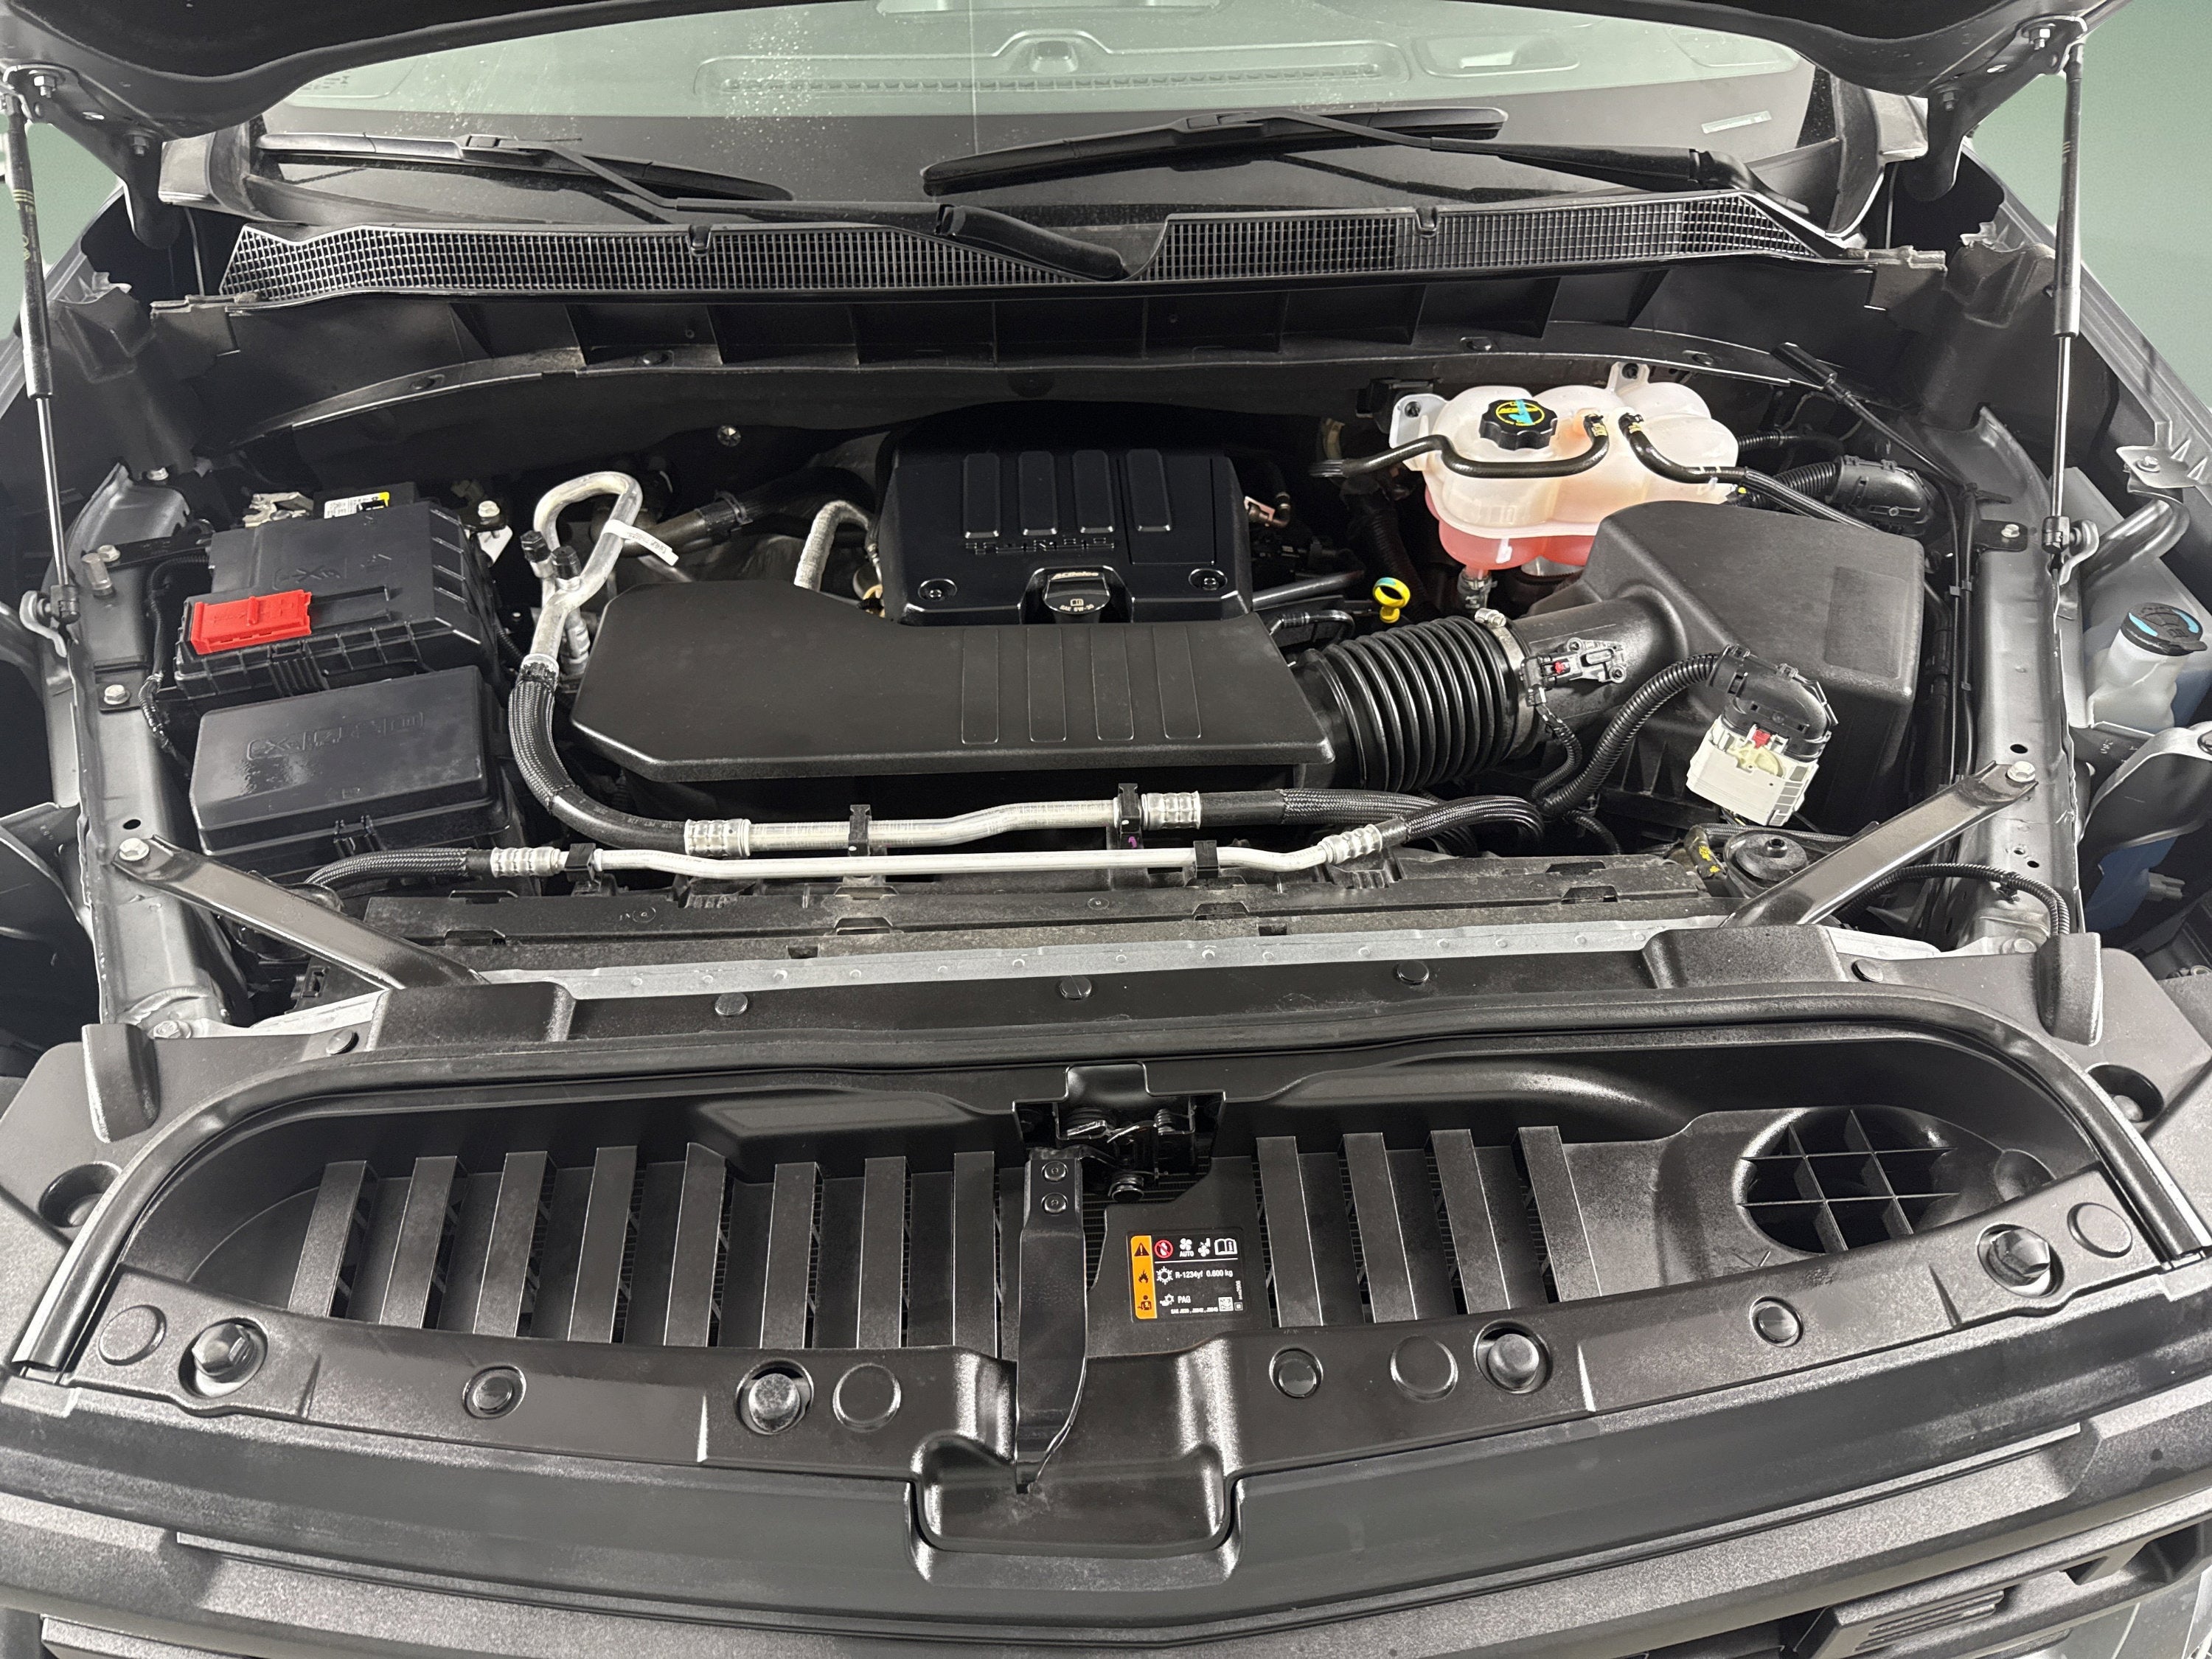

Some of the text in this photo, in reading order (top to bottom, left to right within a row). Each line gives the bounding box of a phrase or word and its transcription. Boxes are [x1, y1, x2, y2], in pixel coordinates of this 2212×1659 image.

[1175, 1270, 1203, 1279] R-1234yf
[1224, 1270, 1234, 1278] kg
[1178, 1295, 1192, 1304] PAG
